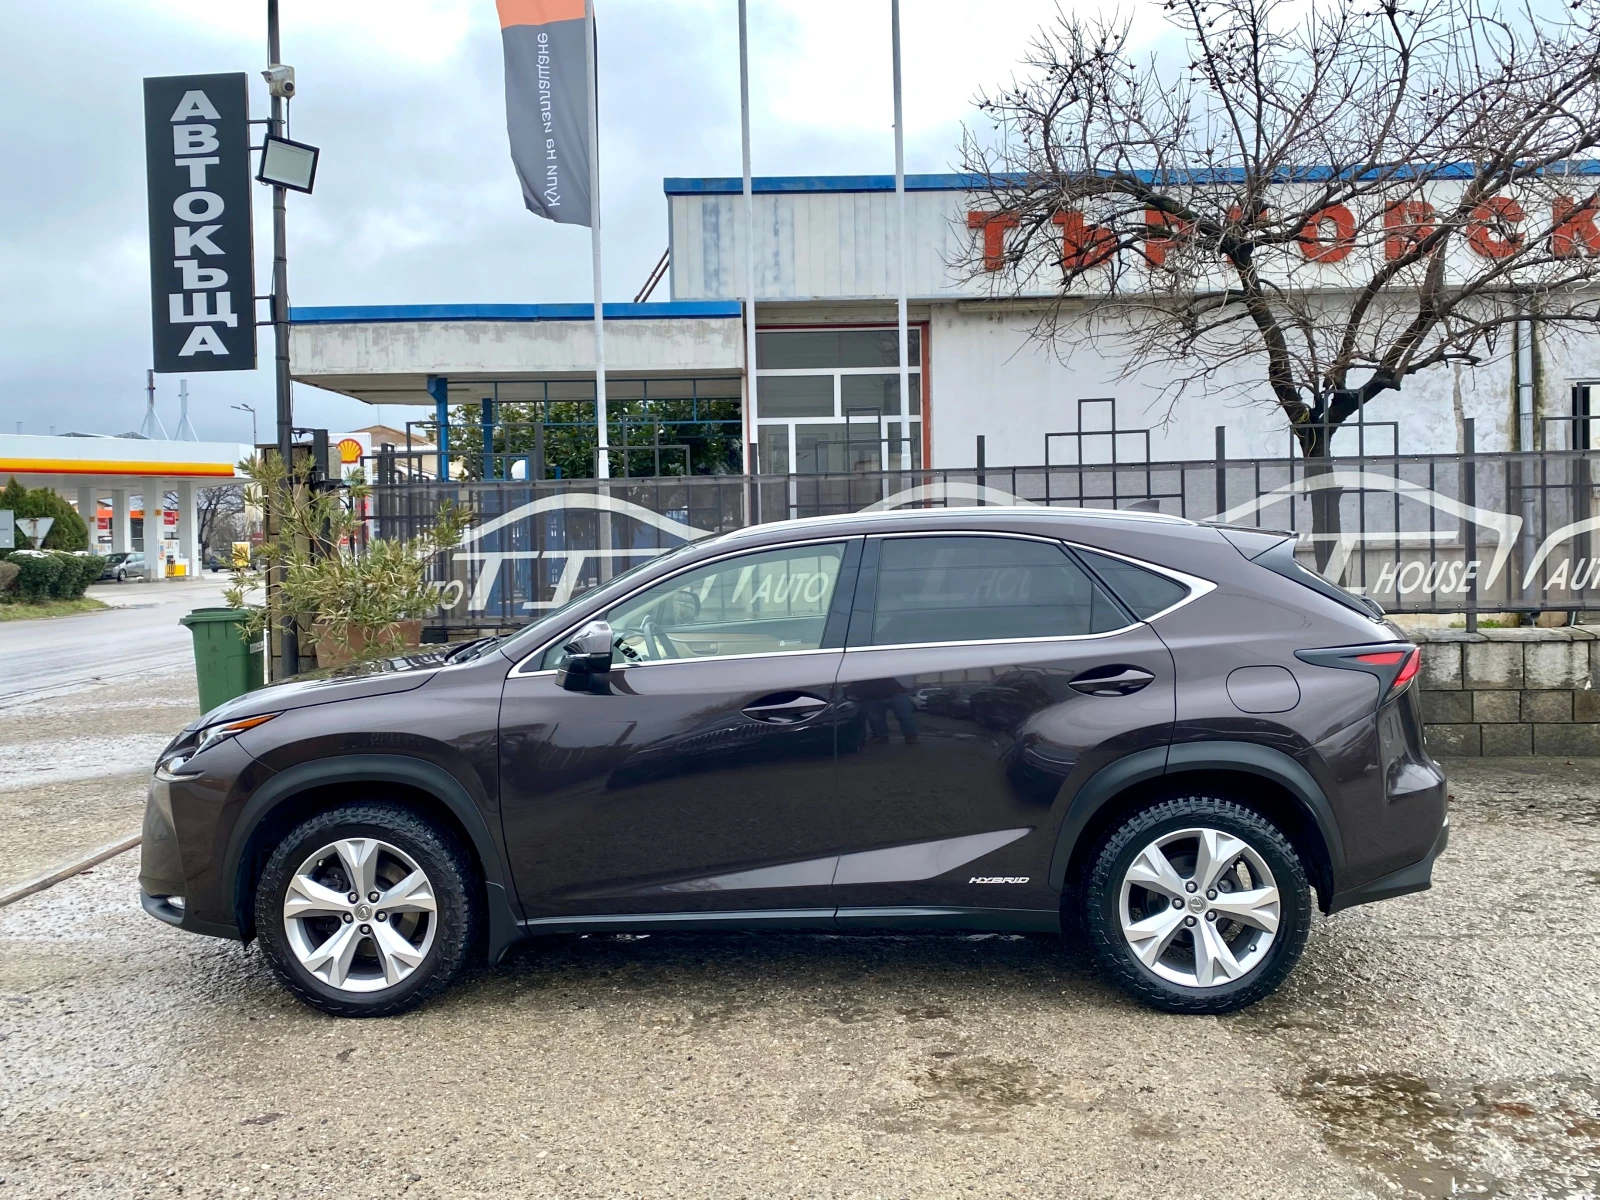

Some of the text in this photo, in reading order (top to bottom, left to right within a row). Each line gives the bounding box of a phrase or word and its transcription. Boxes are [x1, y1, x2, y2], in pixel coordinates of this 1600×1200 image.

[168, 89, 238, 358] АВТОКЪЩА
[750, 572, 829, 604] AUTO
[1373, 560, 1482, 594] HOUSE
[968, 876, 1030, 884] HYBRID
